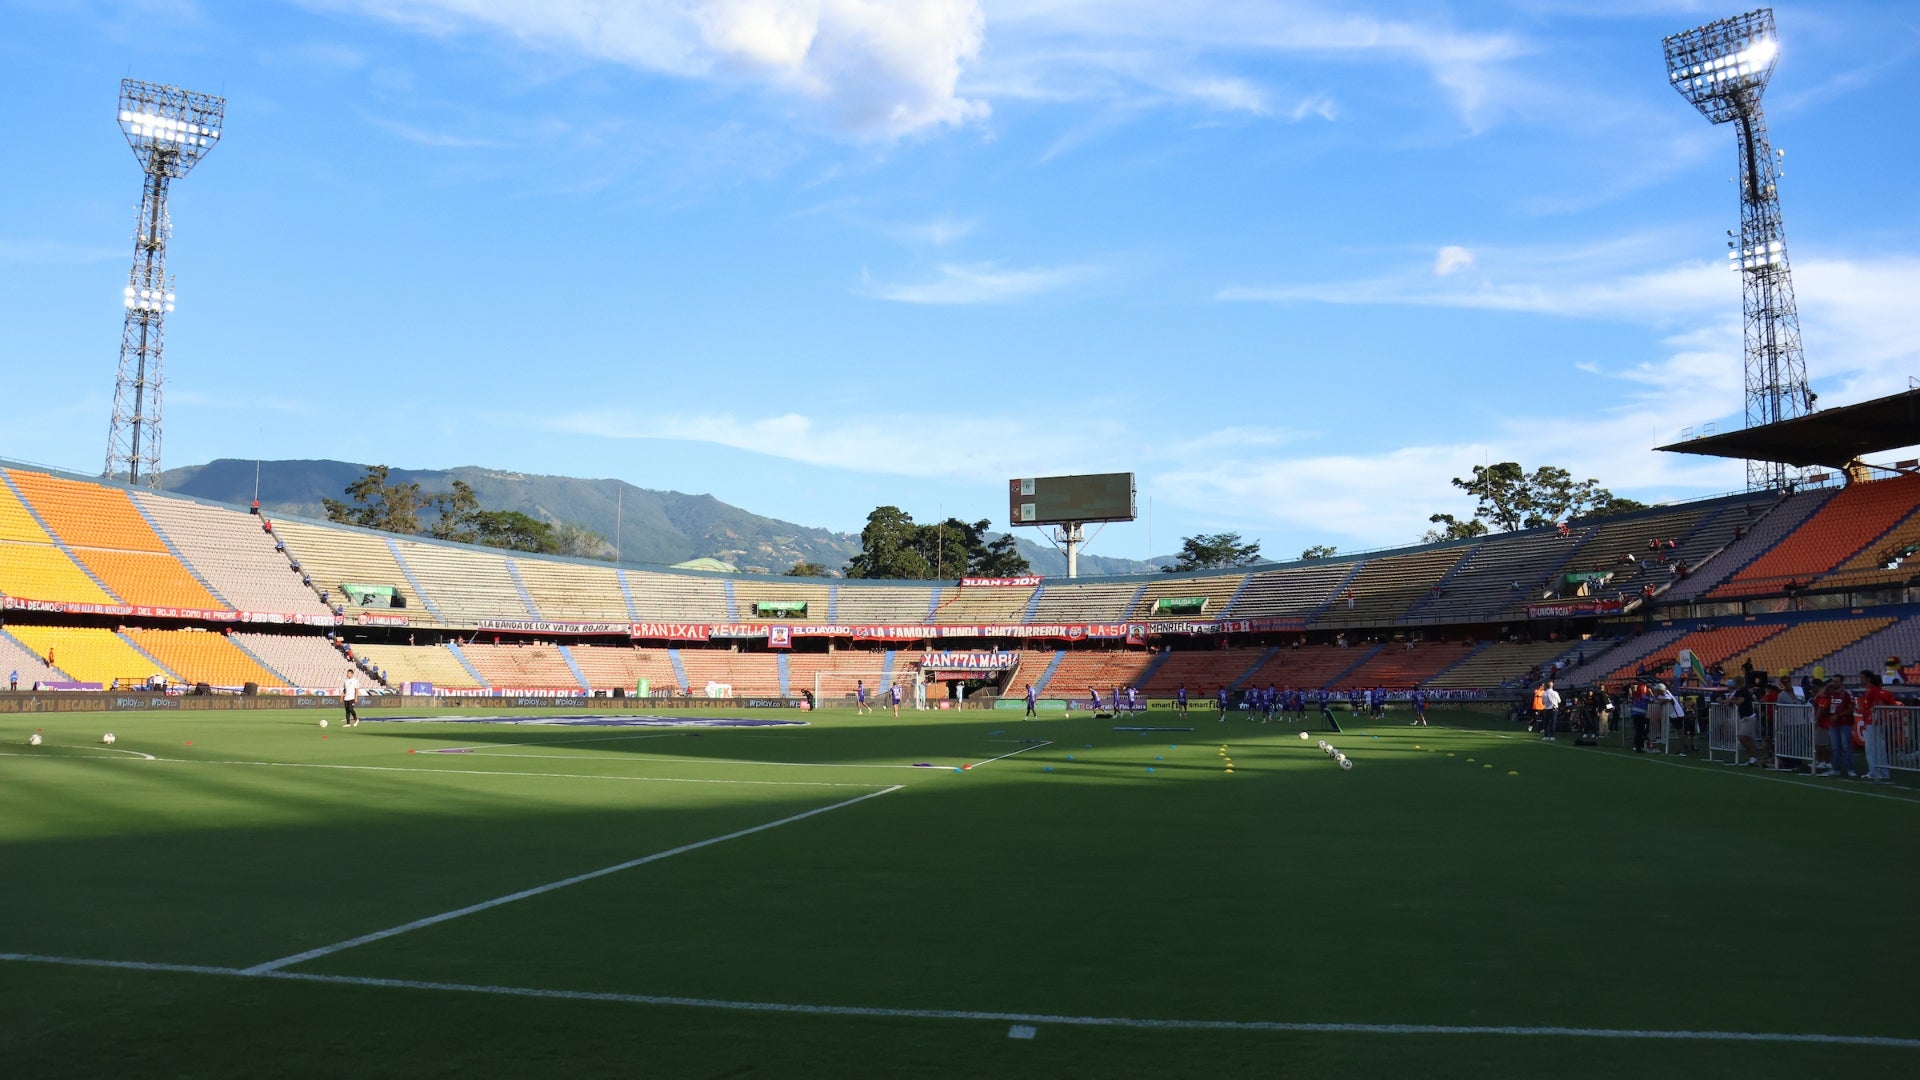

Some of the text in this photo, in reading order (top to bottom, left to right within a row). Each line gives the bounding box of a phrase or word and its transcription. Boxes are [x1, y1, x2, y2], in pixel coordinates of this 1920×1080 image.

[963, 578, 1001, 586] JUAN
[28, 602, 55, 612] DECANO
[138, 607, 153, 616] DEL
[181, 609, 201, 617] COMO
[213, 611, 237, 620] PADRE
[553, 624, 580, 632] VATOX
[583, 624, 610, 632] ROJOX
[632, 623, 706, 639] GRANIXAL
[711, 624, 769, 637] XEVILLA
[793, 626, 850, 635] EL GUAYABO
[870, 625, 1067, 638] LA FAMOXA BANDA CHA77ARREROX
[923, 653, 978, 668] XAN77A
[41, 700, 55, 711] TU
[58, 699, 106, 711] RECARGA
[246, 699, 255, 709] TU
[257, 699, 290, 709] RECARGA
[462, 699, 507, 708] RECARGA
[588, 700, 624, 708] RECIBE
[626, 700, 652, 708] 100%
[672, 700, 686, 708] TU
[689, 700, 737, 708] RECARGA
